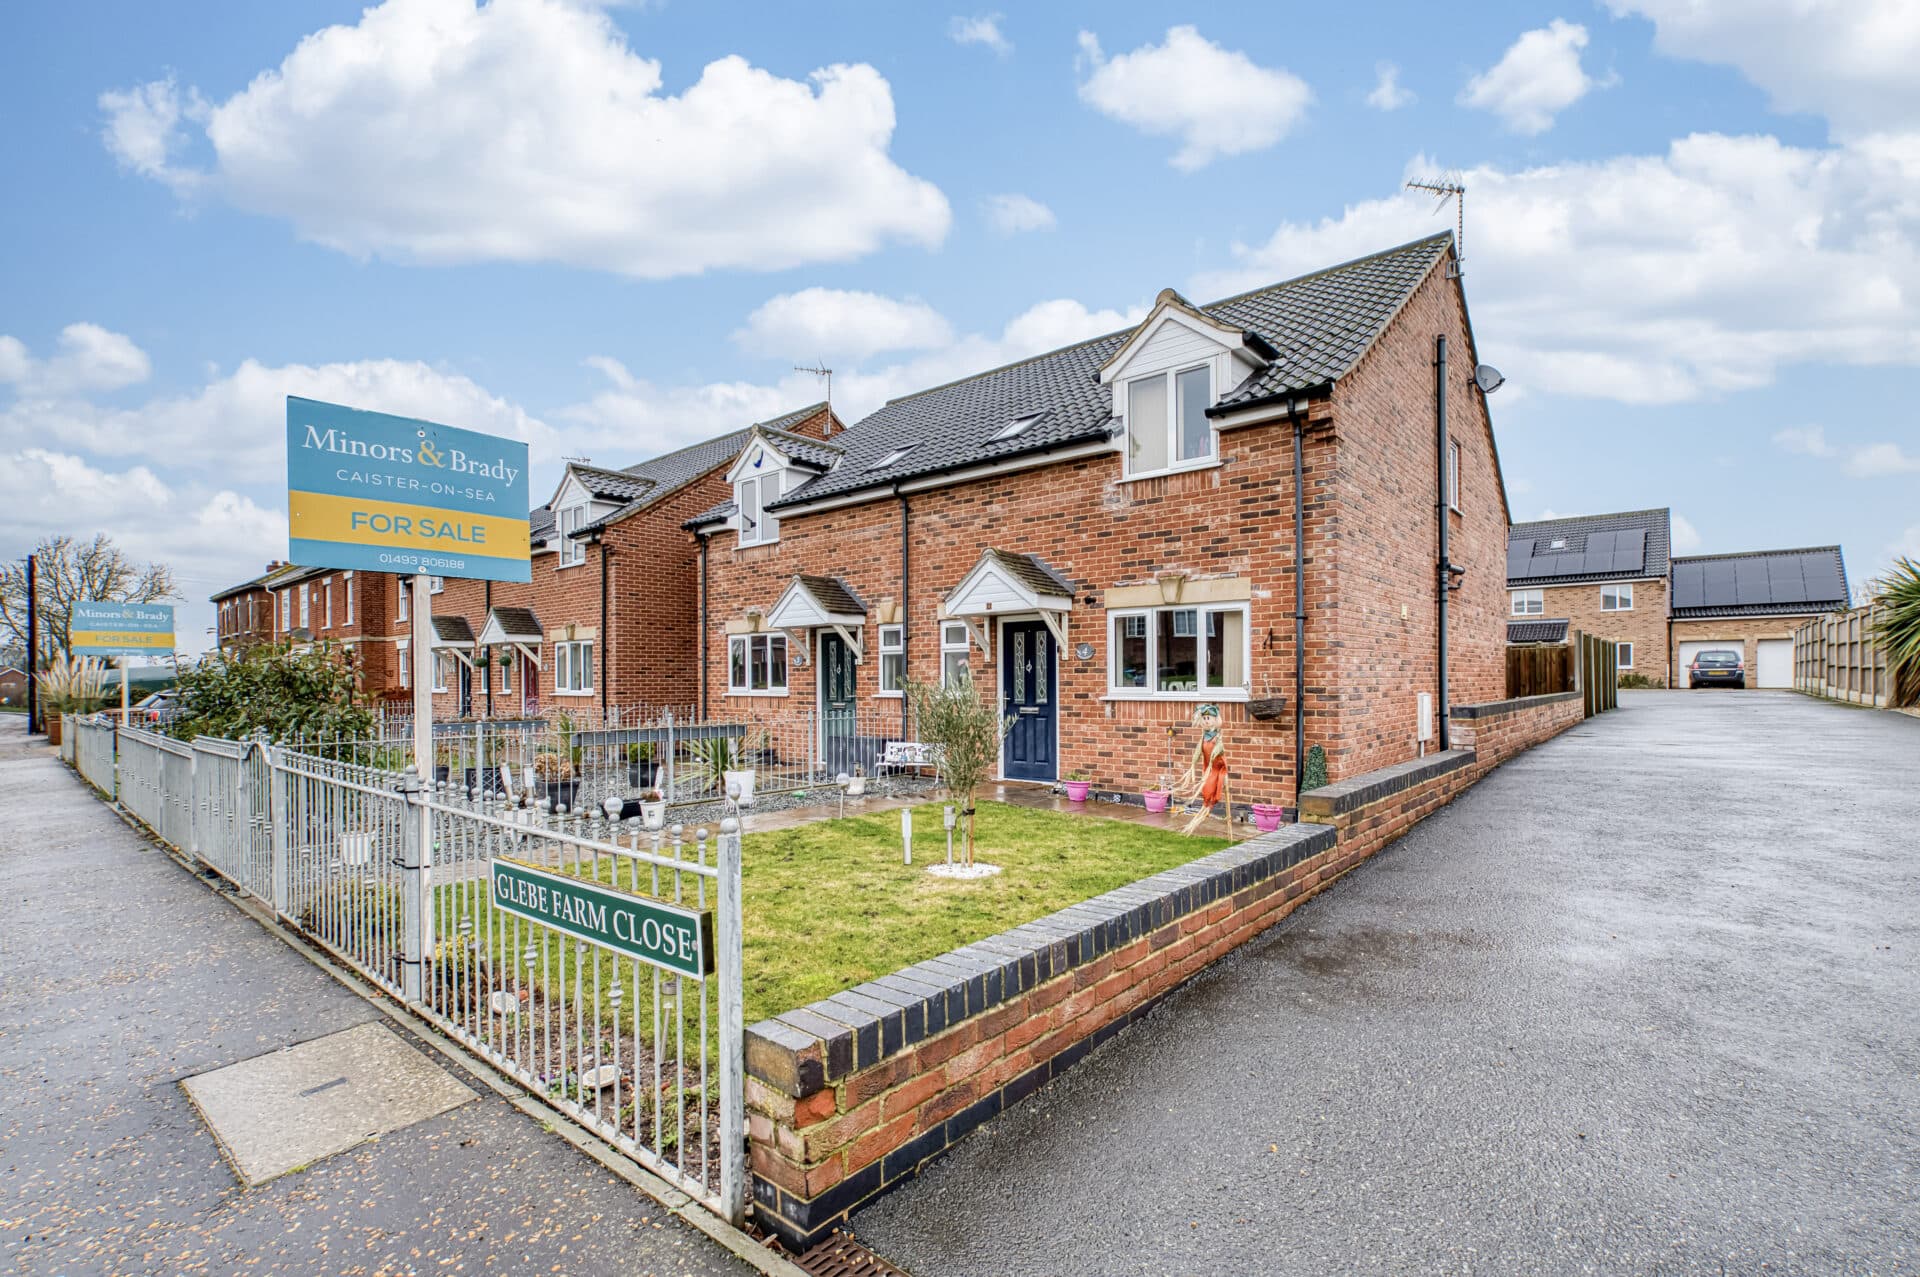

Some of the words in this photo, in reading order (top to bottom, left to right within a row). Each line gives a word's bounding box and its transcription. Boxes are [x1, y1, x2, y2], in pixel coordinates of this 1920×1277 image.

[302, 424, 413, 464] Minors
[417, 440, 446, 469] &
[449, 449, 519, 487] Brady
[336, 469, 496, 502] CAISTER-ON-SEA
[351, 511, 412, 536] FOR
[419, 519, 486, 544] SALE
[379, 553, 418, 565] 01493
[421, 556, 465, 569] 806188
[78, 608, 121, 618] Minors
[122, 608, 134, 619] &
[136, 610, 169, 622] Brady
[95, 634, 120, 643] FOR
[122, 635, 153, 643] SALE
[497, 872, 549, 914] GLEBE
[551, 889, 609, 934] FARM
[612, 908, 693, 962] CLOSE
